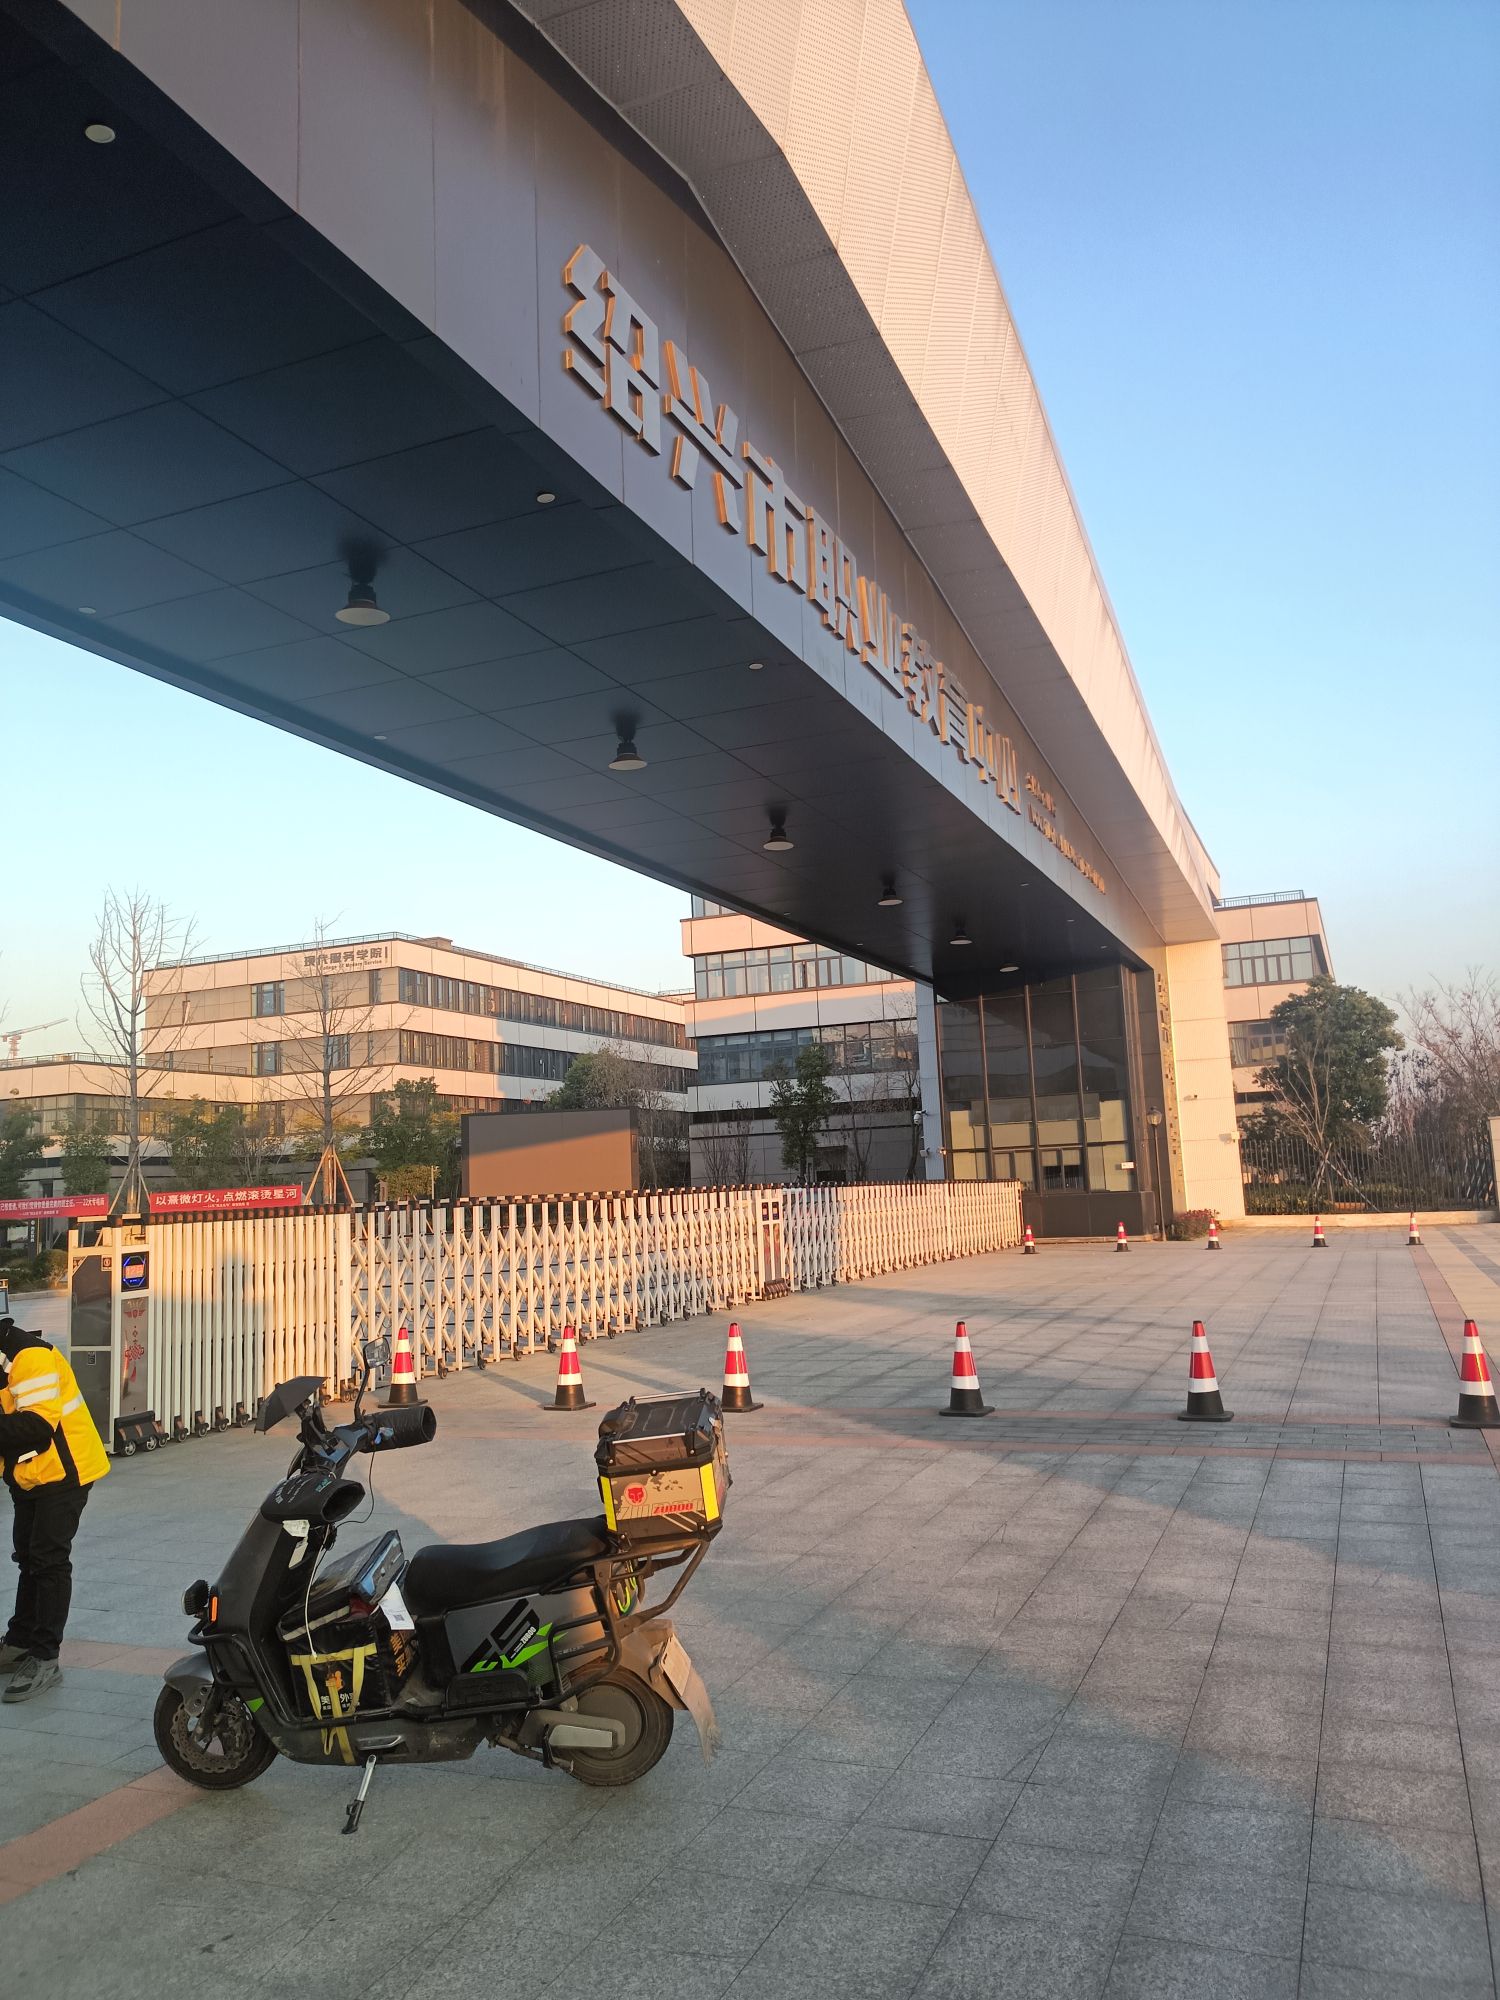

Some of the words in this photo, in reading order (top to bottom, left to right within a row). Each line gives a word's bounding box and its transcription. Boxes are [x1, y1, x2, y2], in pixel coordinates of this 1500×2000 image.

[563, 243, 1022, 816] 绍兴市职业教育中心
[304, 949, 383, 967] 现代服务学院
